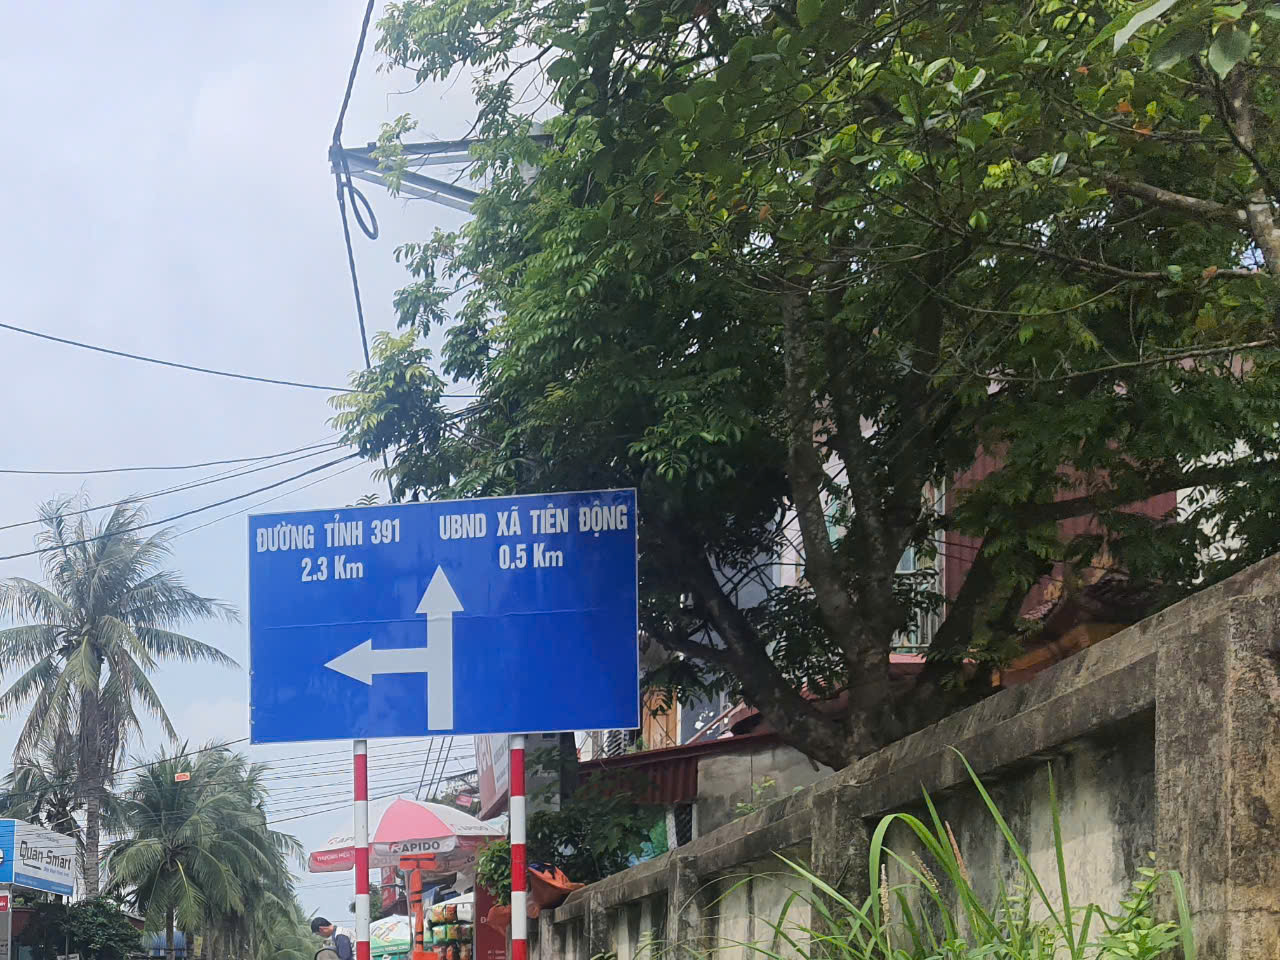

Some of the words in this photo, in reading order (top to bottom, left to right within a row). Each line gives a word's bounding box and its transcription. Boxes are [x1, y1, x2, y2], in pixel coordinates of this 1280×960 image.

[256, 521, 315, 552] ĐƯỜNG
[324, 514, 363, 547] TỈNH
[371, 519, 400, 544] 391
[439, 513, 486, 540] UBND
[497, 507, 521, 536] XÃ
[530, 503, 569, 535] TIÊN
[578, 500, 628, 538] ĐỘNG
[301, 556, 328, 582] 2.3
[334, 555, 363, 579] Km
[499, 545, 526, 570] 0.5
[533, 543, 563, 568] Km
